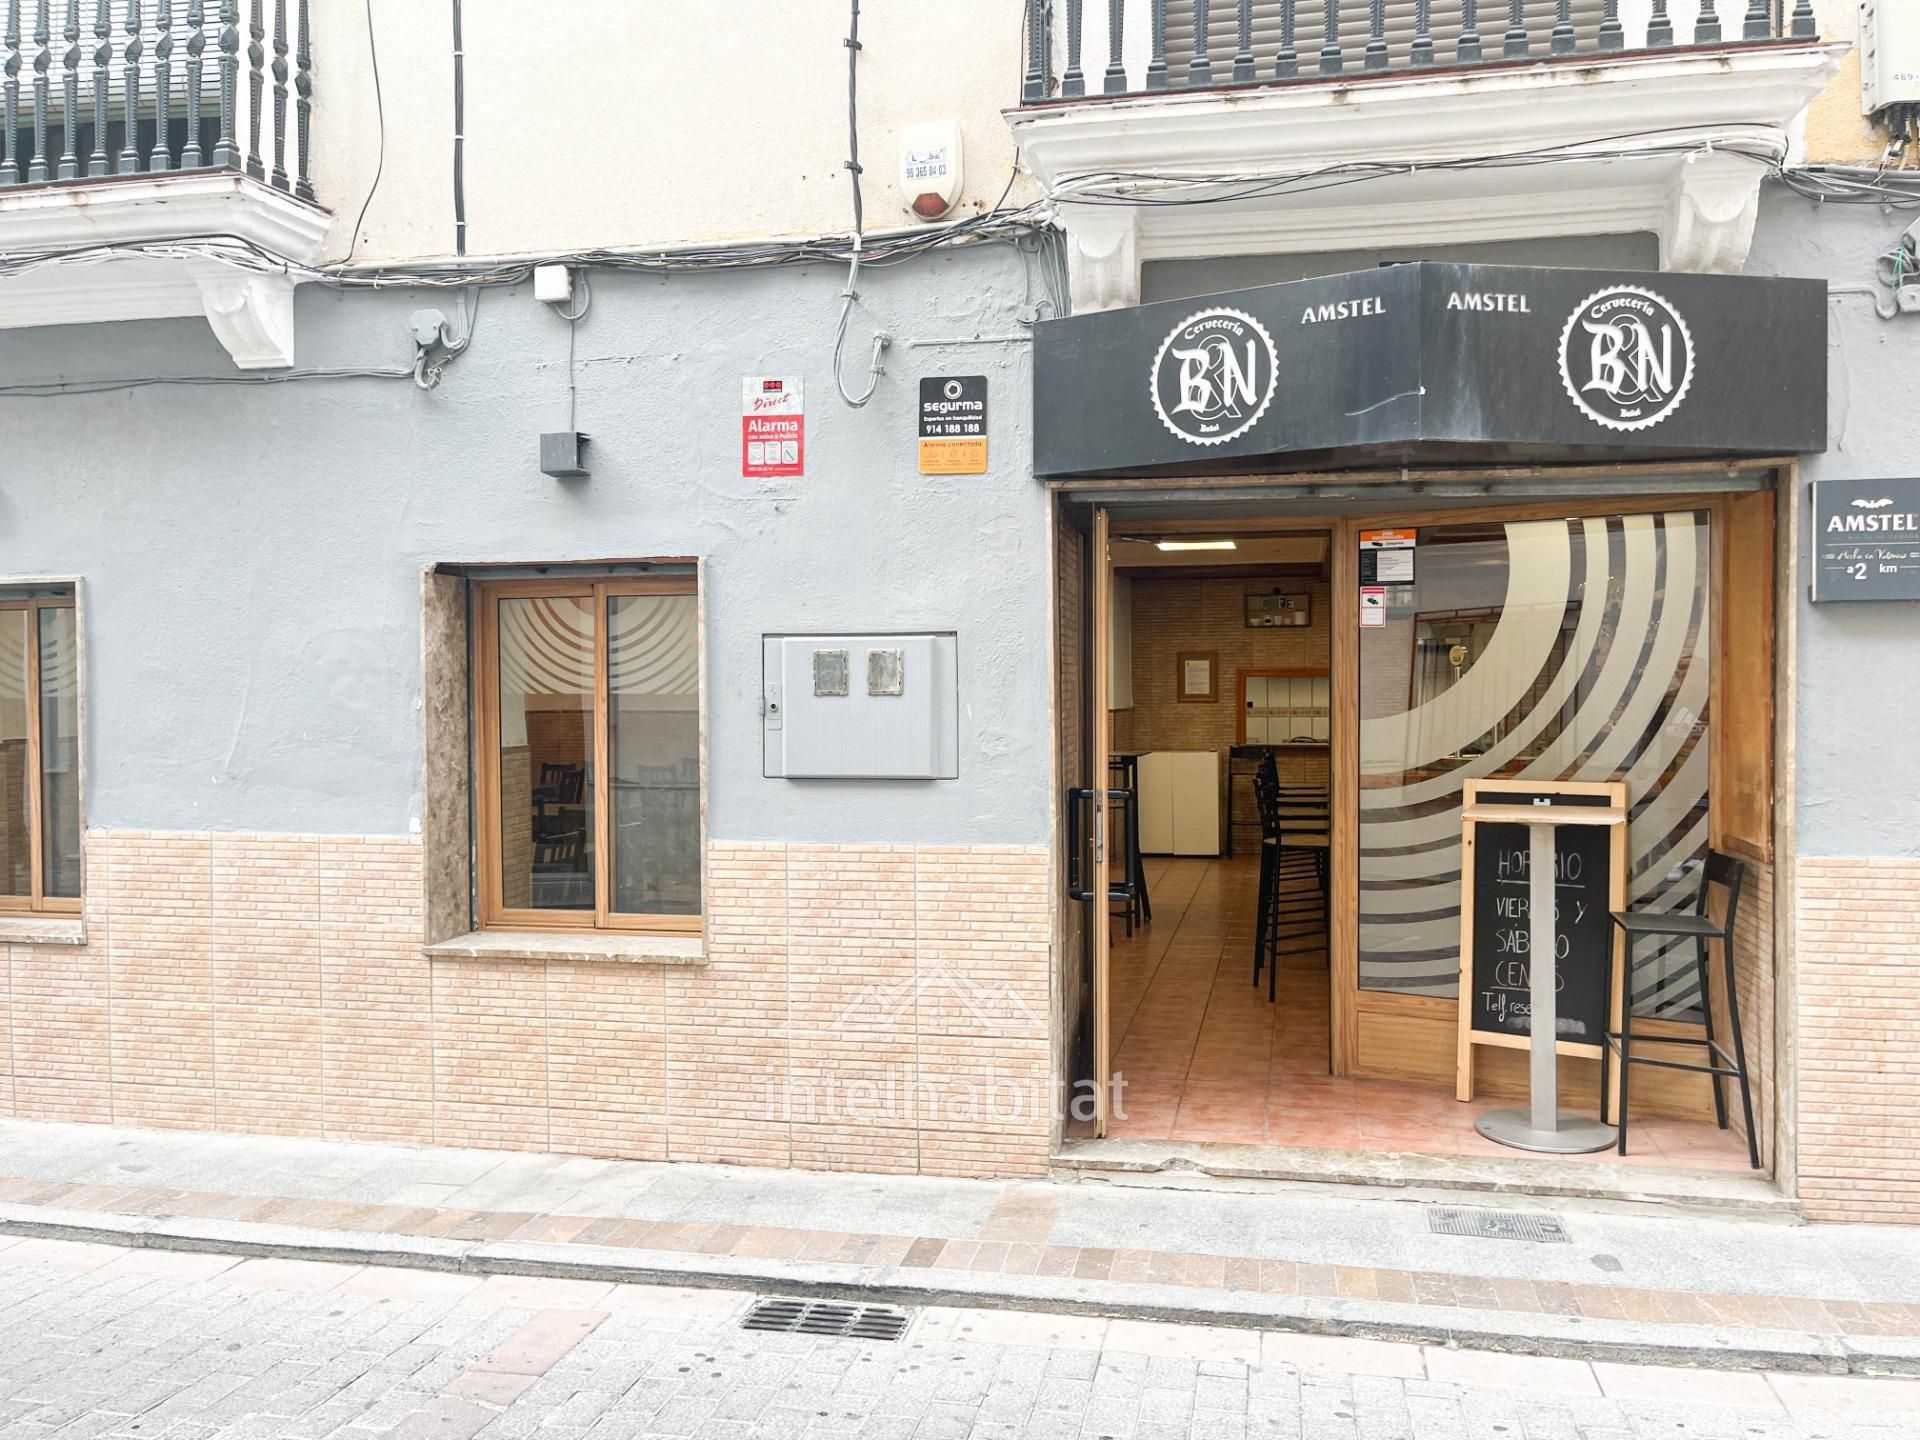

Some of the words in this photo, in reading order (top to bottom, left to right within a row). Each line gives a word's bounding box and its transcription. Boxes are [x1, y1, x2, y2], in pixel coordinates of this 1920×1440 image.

[915, 166, 927, 178] 365
[938, 163, 947, 176] 03
[1300, 295, 1387, 325] AMSTEL
[1447, 291, 1532, 313] AMSTEL
[1590, 297, 1656, 319] Cervecería
[1184, 318, 1245, 340] Cervecería
[753, 392, 793, 411] Direct
[923, 400, 983, 414] segurma
[748, 418, 799, 433] Alarma
[926, 424, 942, 434] 914
[945, 423, 961, 433] 188
[964, 423, 980, 433] 188
[923, 441, 947, 449] Alarma
[947, 440, 983, 448] conectada
[1826, 513, 1918, 532] AMSTEL
[1879, 563, 1898, 574] km
[1498, 849, 1582, 880] HORIO
[1496, 896, 1560, 921] VIERS
[1495, 922, 1570, 959] SÁBO
[1495, 960, 1565, 992] CENS
